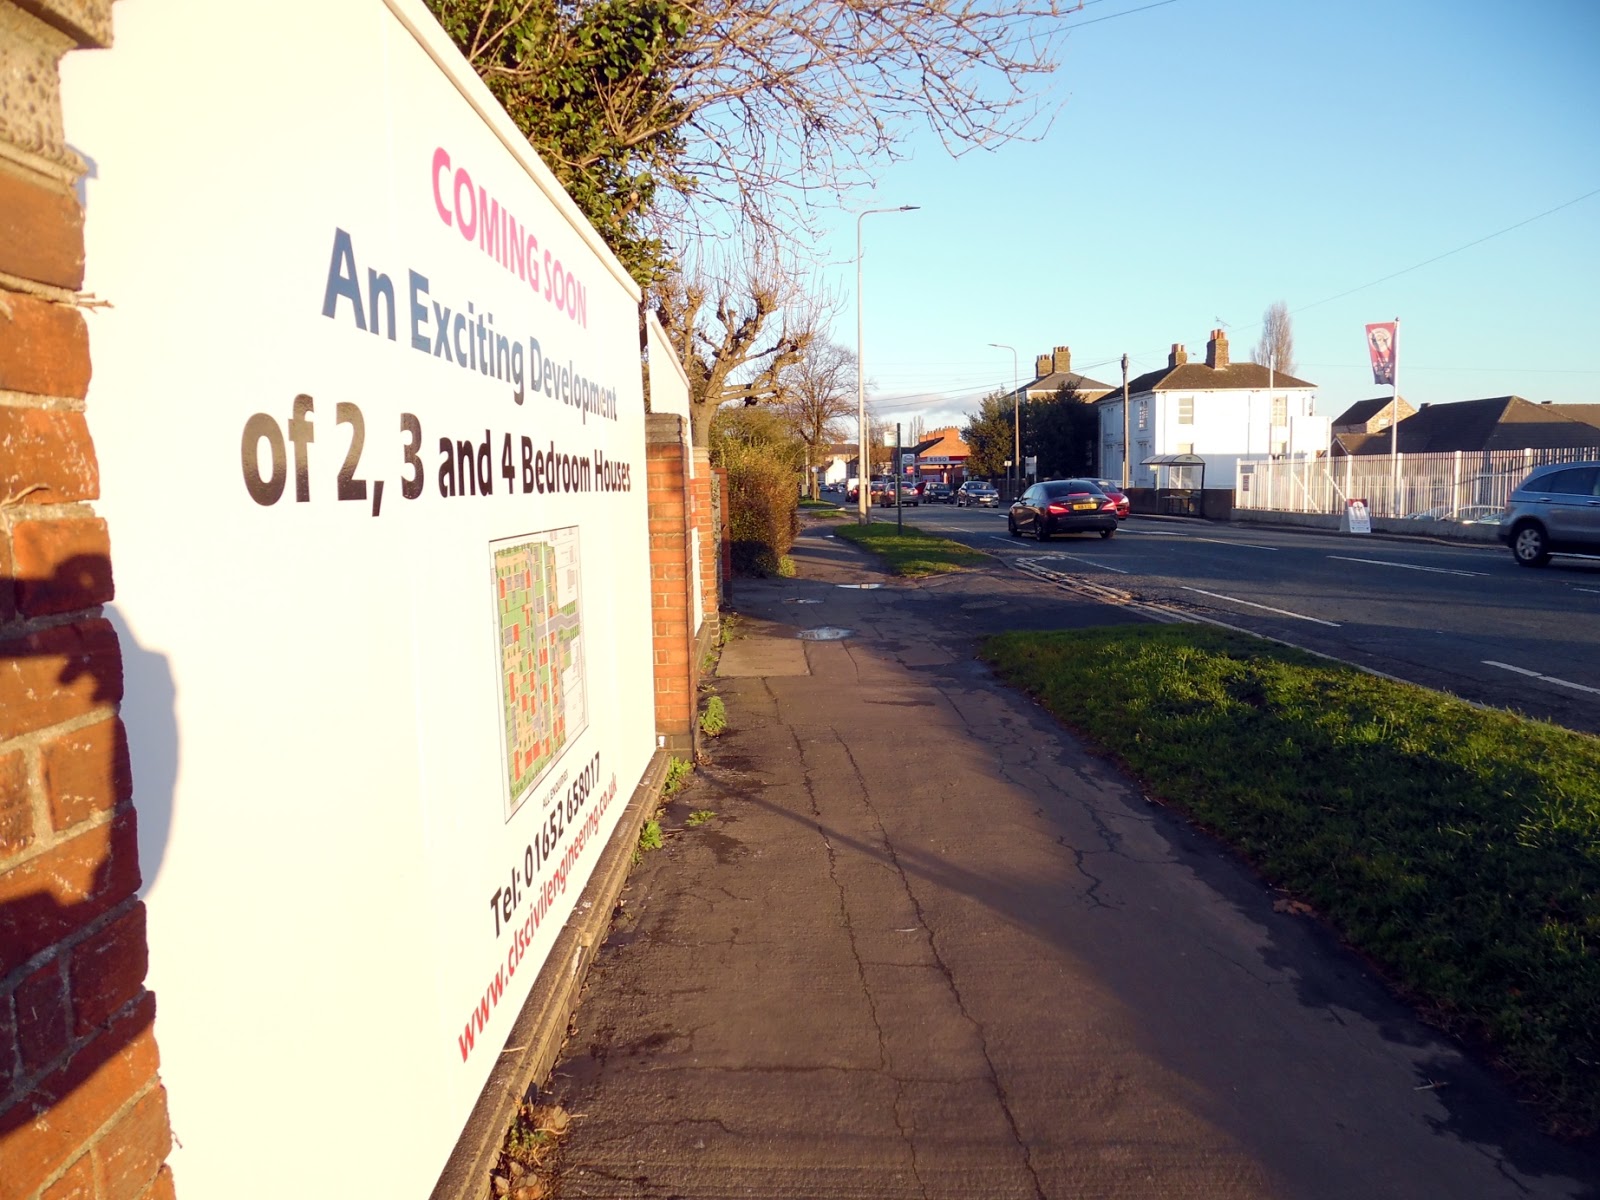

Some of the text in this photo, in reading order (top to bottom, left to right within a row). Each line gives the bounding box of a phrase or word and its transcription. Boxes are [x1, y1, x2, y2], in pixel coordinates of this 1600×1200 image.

[321, 226, 618, 426] An Exciting Development
[431, 146, 588, 330] COMING SOON
[240, 393, 632, 518] of 2, 3 and 4 Bedroom Houses
[457, 771, 618, 1064] www.clscivilengineering.co.uk
[490, 750, 600, 939] Tel: 01652 658017
